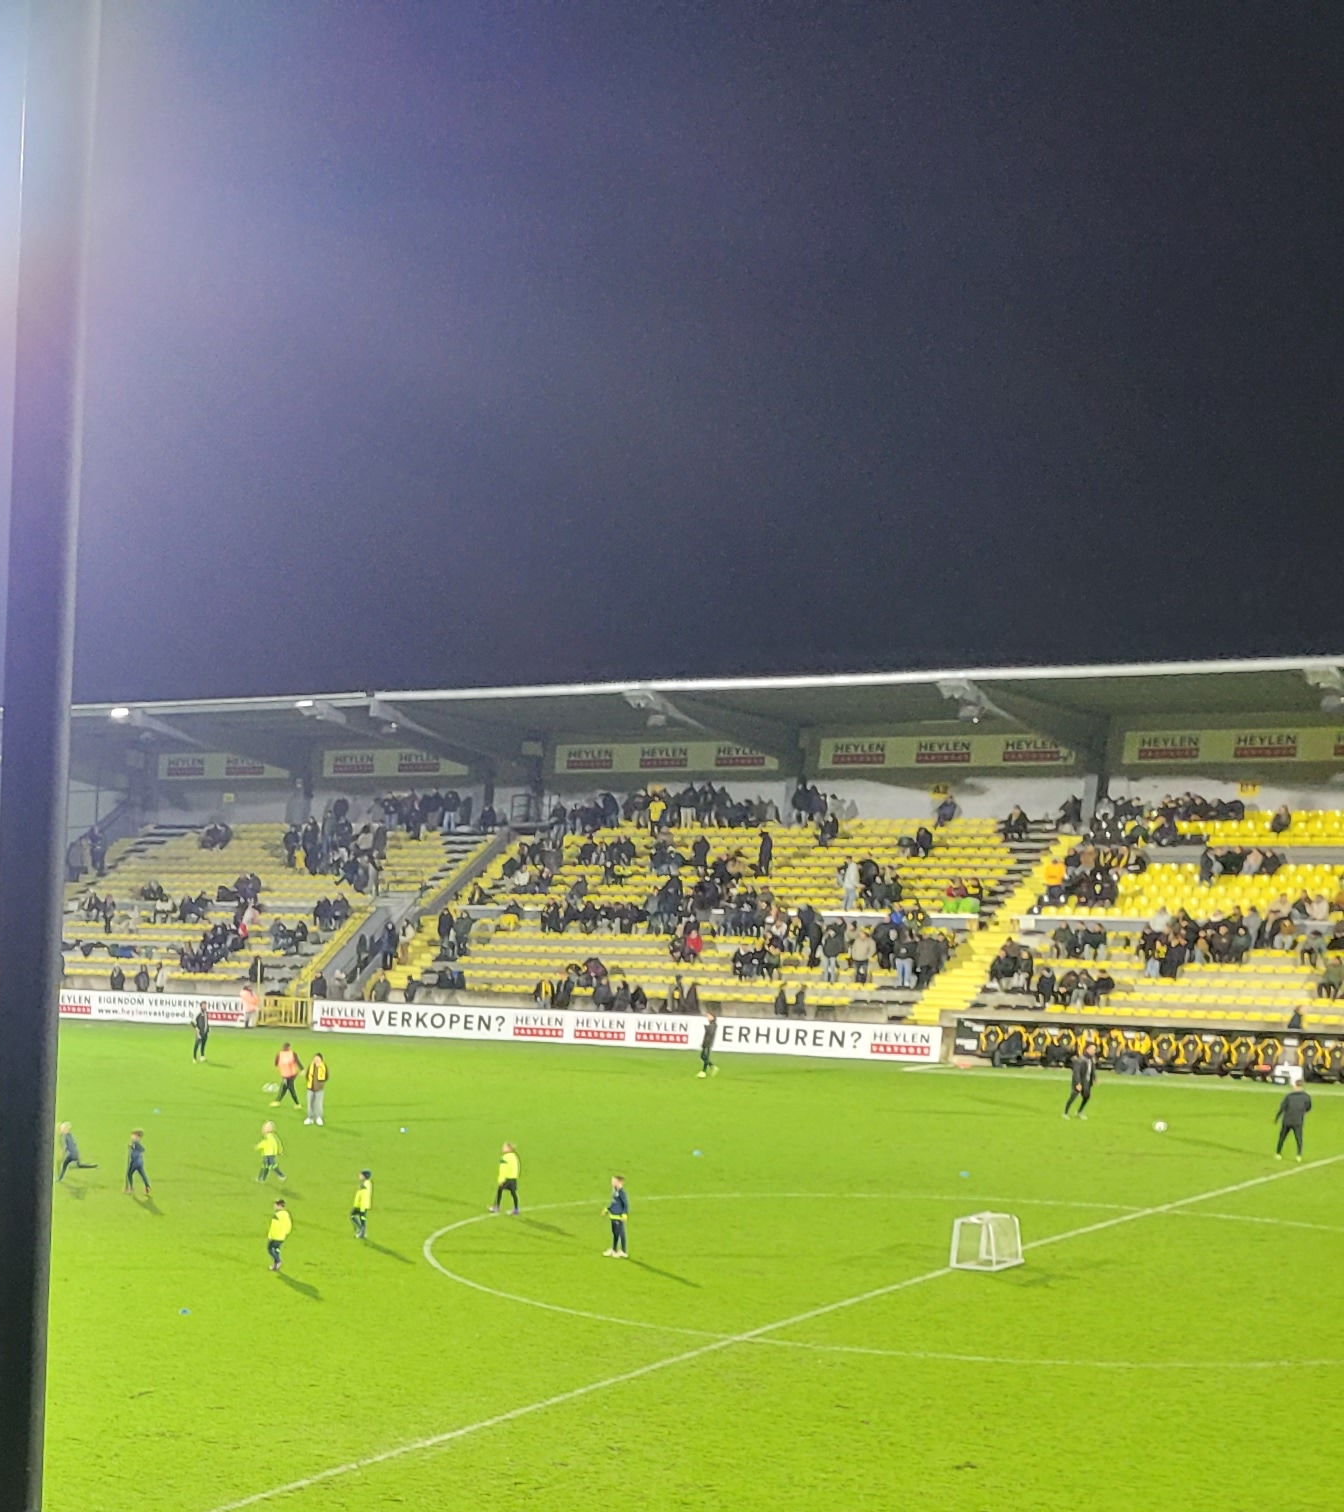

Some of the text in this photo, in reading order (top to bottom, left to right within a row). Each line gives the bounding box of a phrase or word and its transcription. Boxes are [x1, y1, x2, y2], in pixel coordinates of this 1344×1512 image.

[1141, 736, 1199, 747] HEYLEN
[1237, 734, 1296, 746] HEYLEN
[835, 742, 885, 753] HEYLEN
[919, 741, 971, 752] HEYLEN
[59, 994, 92, 1006] EYLEN
[98, 995, 146, 1007] EIGENDOM
[322, 1006, 365, 1018] HEYLEN
[372, 1009, 506, 1033] VERKOPEN?
[515, 1015, 564, 1027] HEYLEN
[576, 1017, 625, 1030] HEYLEN
[637, 1020, 688, 1033] HEYLEN
[721, 1025, 863, 1049] ERHUREN?
[872, 1031, 930, 1044] HEYLEN
